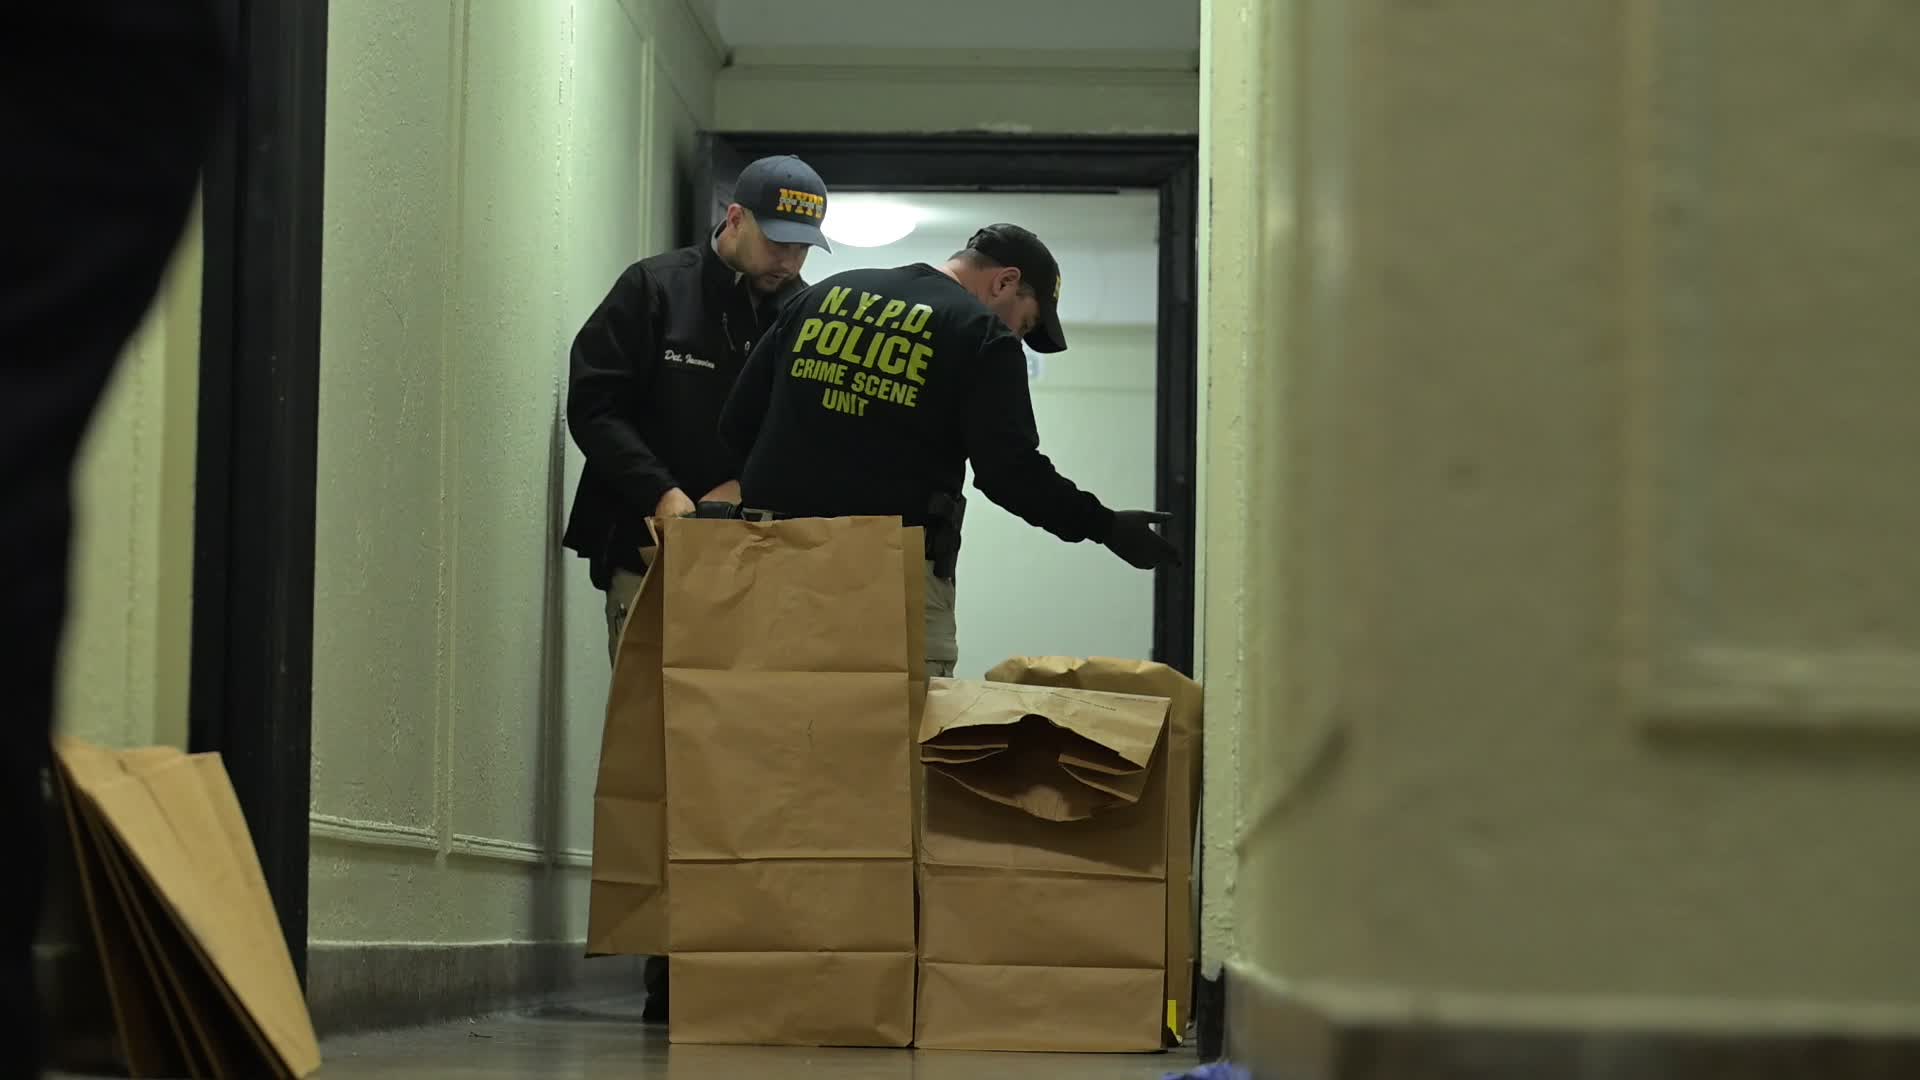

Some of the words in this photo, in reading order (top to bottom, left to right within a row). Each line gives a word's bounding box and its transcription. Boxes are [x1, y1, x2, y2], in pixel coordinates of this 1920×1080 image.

[818, 286, 934, 340] N.Y.P.D.
[792, 318, 934, 386] POLICE
[791, 358, 848, 385] CRIME
[851, 372, 919, 407] SCENE
[822, 388, 869, 416] UNIT
